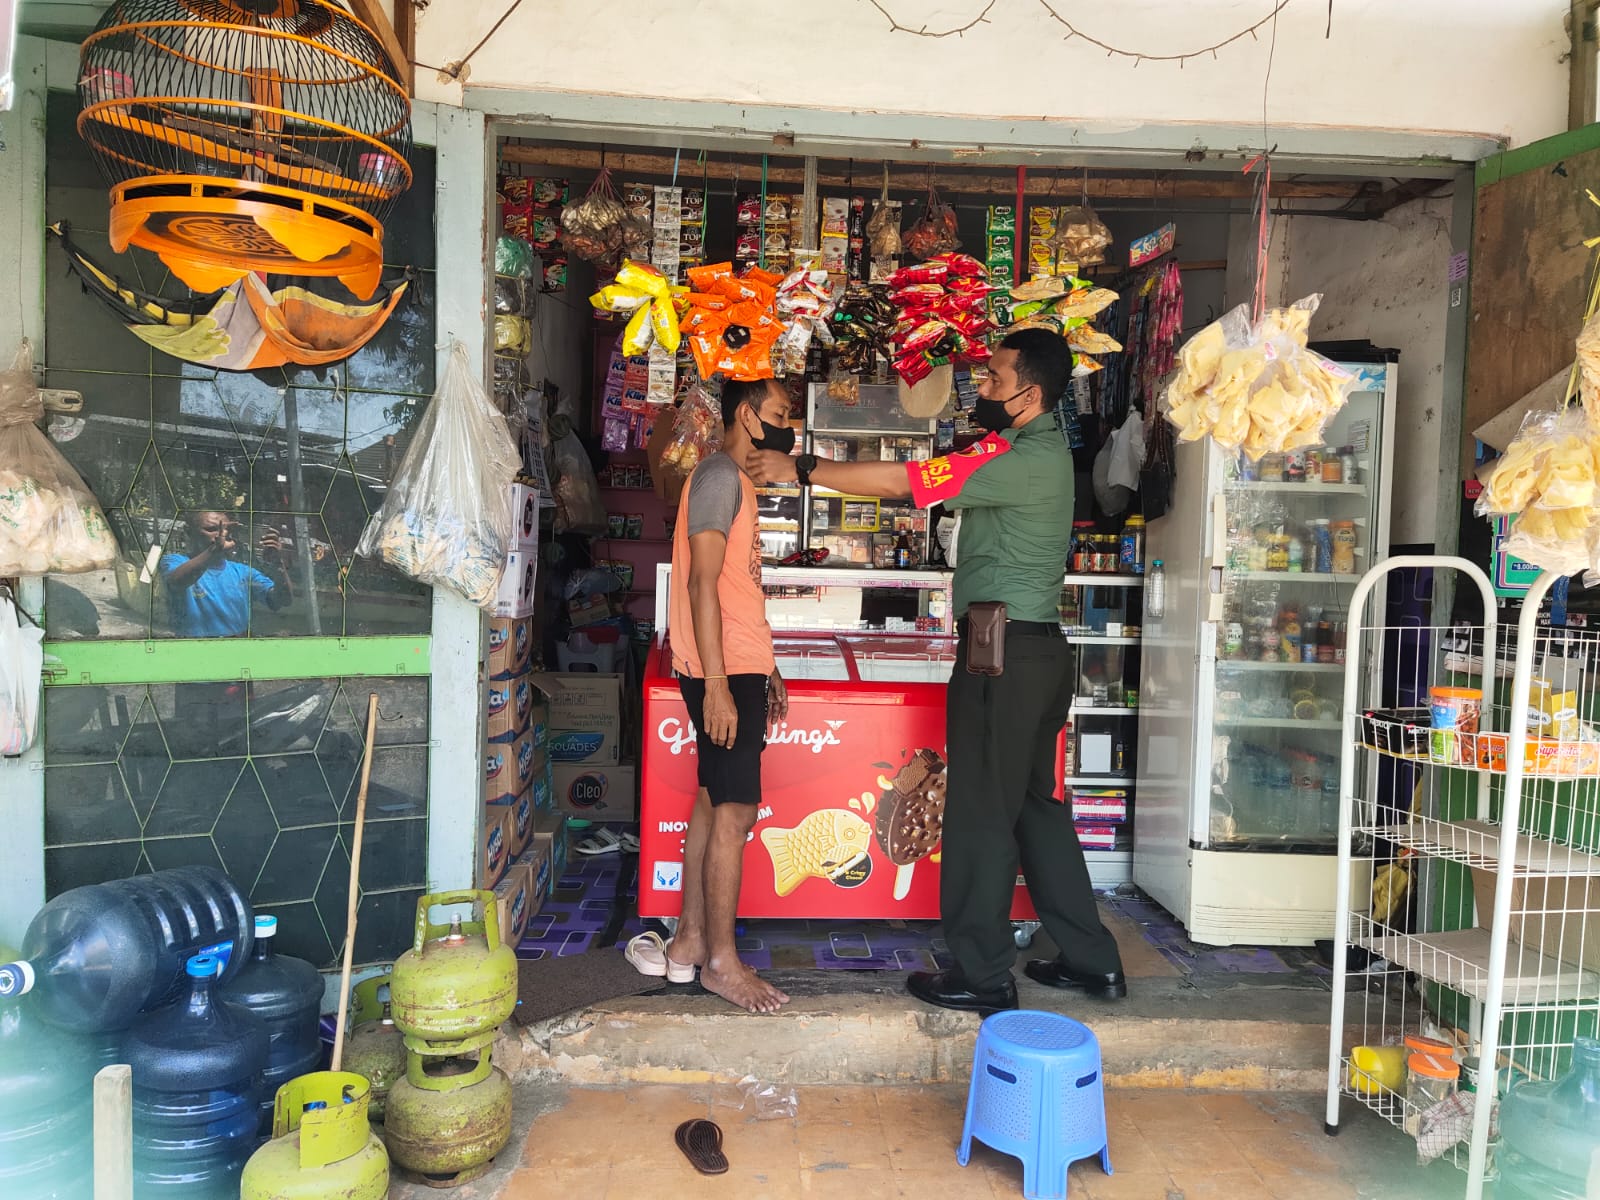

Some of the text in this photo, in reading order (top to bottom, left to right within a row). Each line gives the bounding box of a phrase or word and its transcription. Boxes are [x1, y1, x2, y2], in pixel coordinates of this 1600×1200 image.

[628, 194, 647, 203] TOP
[683, 197, 703, 206] TOP
[683, 233, 702, 241] TOP
[576, 782, 601, 799] Cleo
